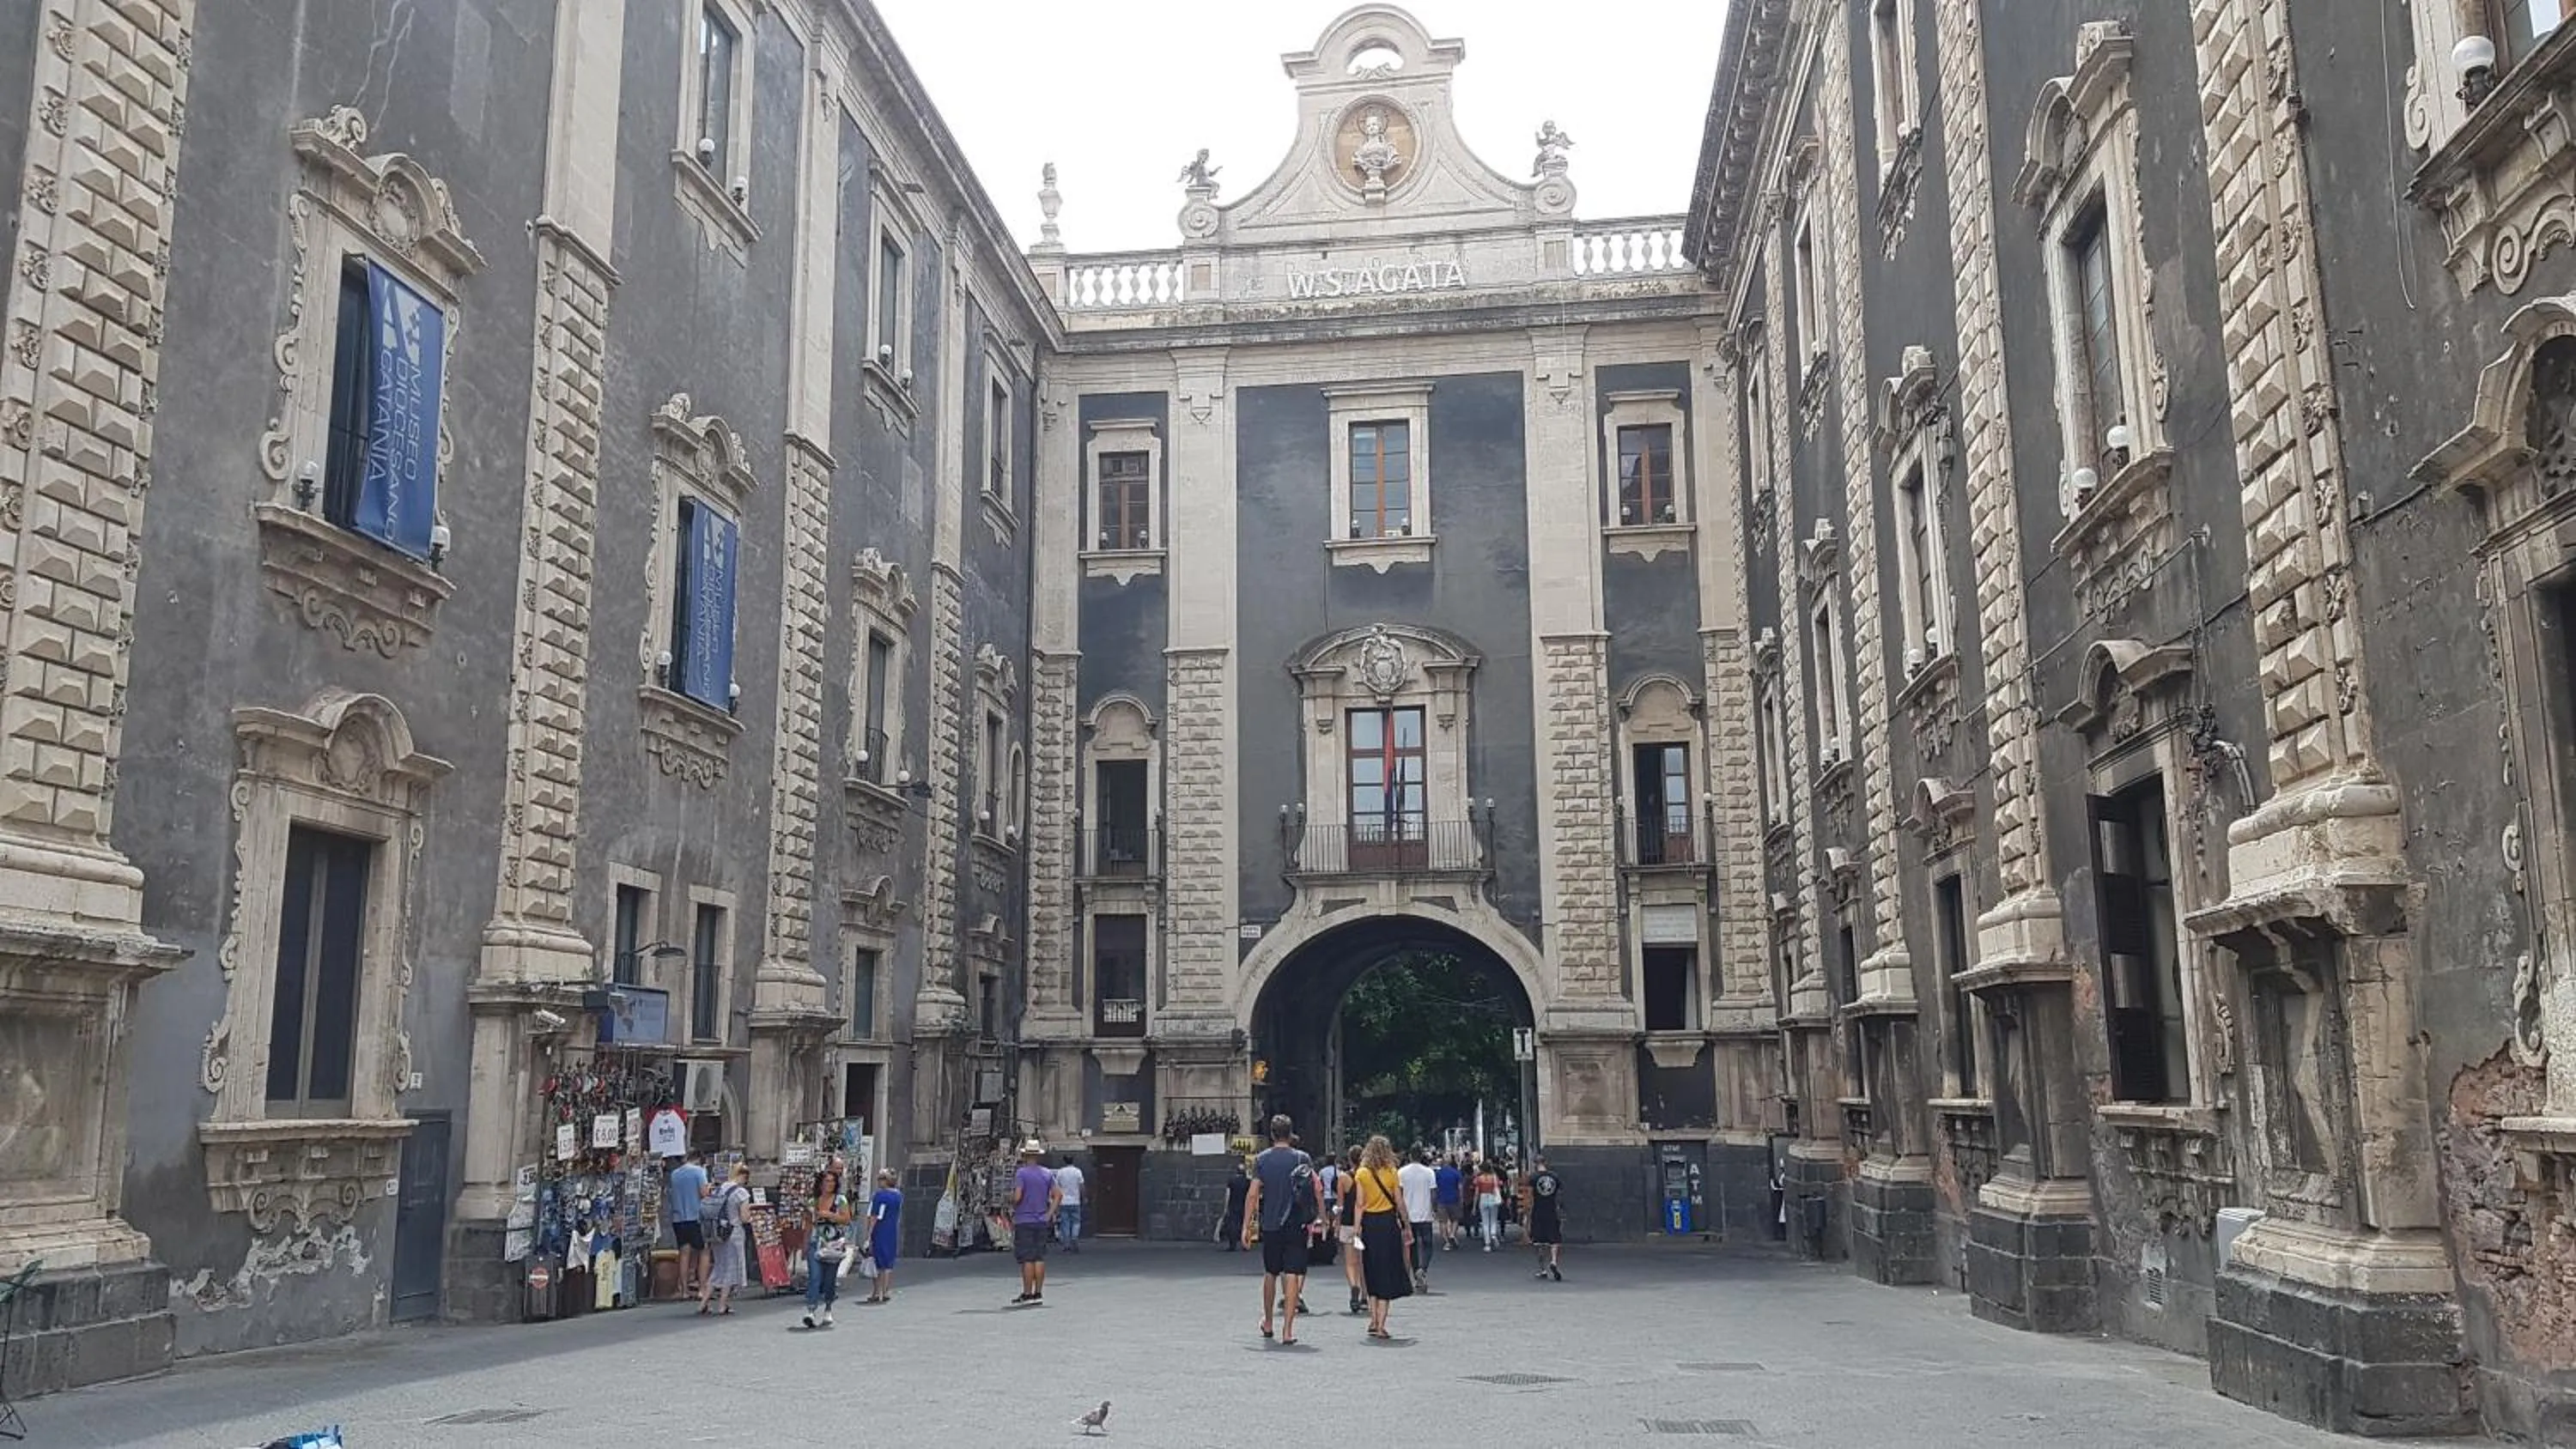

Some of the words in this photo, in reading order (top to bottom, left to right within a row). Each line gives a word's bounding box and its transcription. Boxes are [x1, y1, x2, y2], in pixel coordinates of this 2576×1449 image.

[369, 349, 393, 482] CATANIA
[384, 356, 409, 541] DIOCESANO
[405, 364, 422, 482] MUSEO
